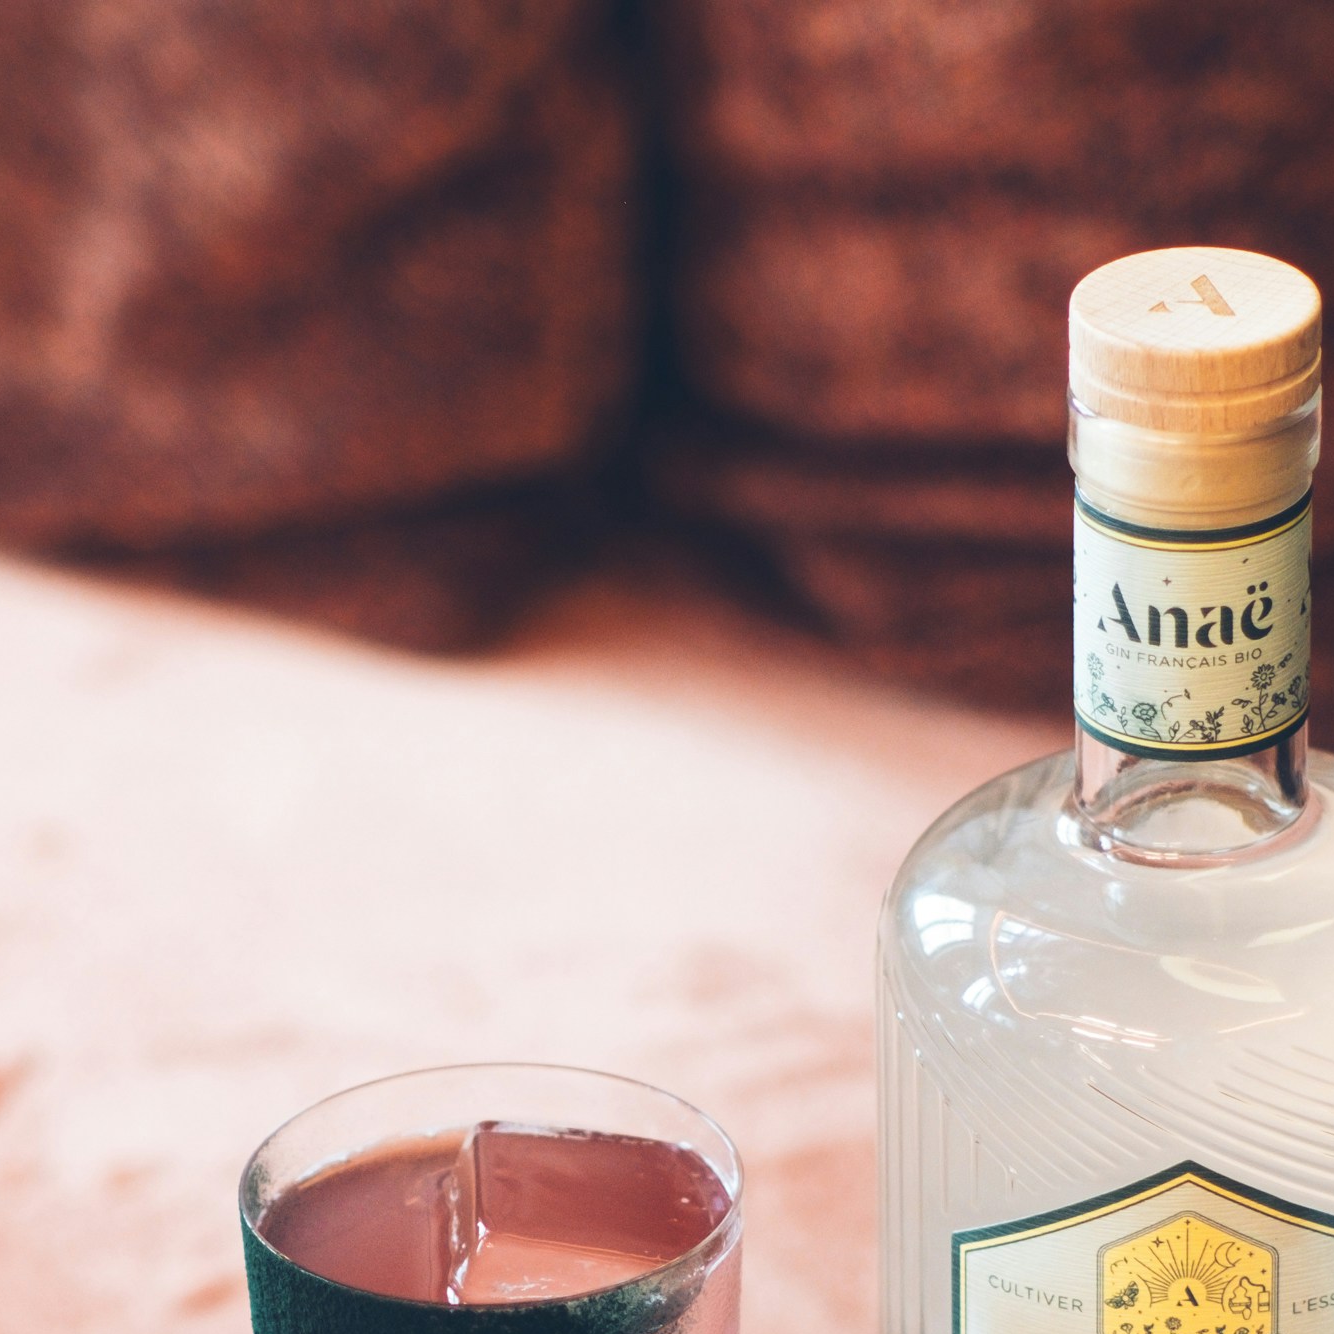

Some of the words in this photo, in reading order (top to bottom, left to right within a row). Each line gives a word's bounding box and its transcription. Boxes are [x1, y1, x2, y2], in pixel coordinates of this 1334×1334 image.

[1097, 580, 1274, 649] Anaë
[1105, 643, 1131, 661] GIN
[1137, 652, 1228, 670] FRANÇAIS
[1234, 647, 1263, 664] BIO
[987, 1274, 1084, 1313] CULTIVER
